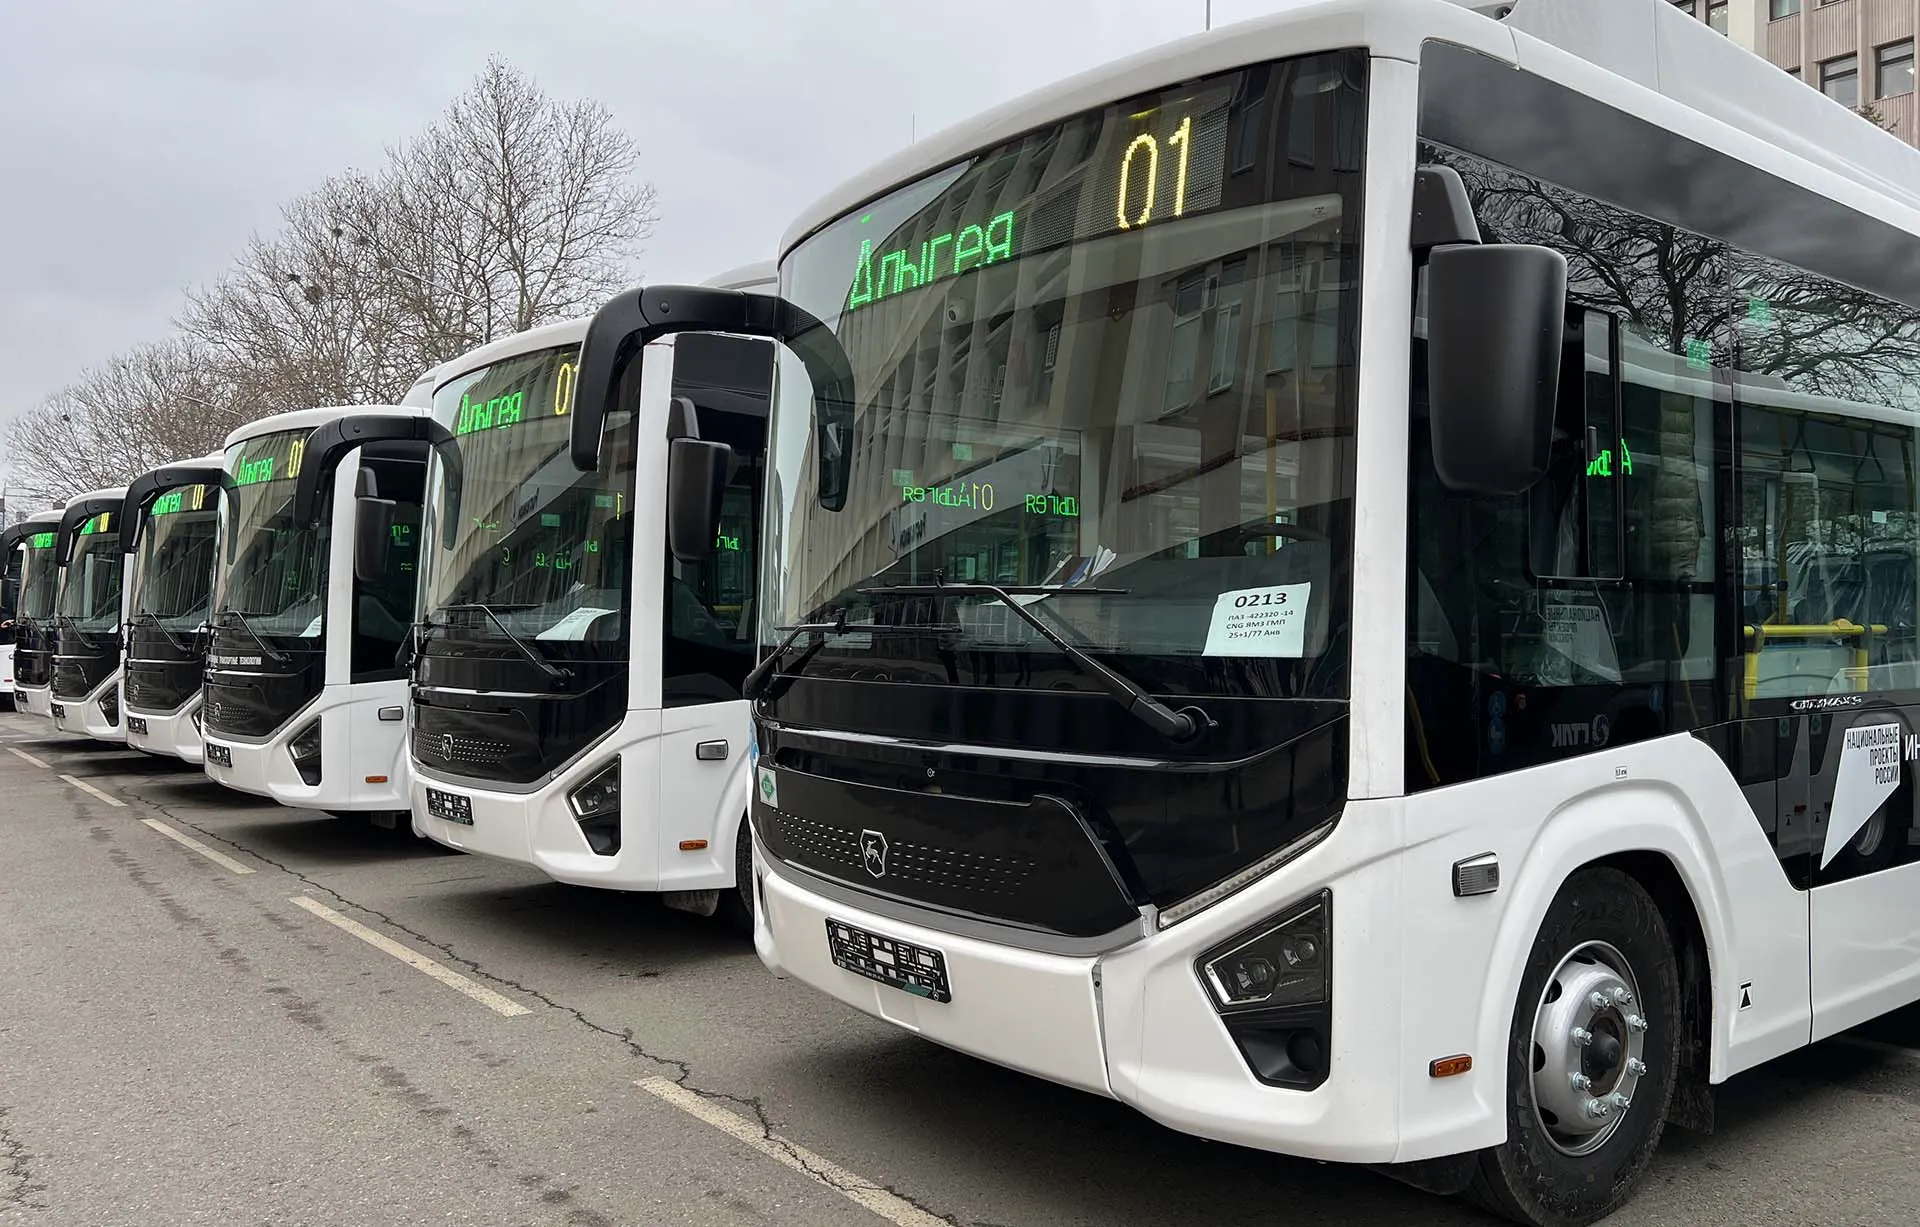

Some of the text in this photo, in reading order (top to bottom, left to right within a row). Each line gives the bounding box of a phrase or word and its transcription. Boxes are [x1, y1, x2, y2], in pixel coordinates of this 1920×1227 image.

[1117, 116, 1192, 230] 01
[555, 362, 579, 415] 0
[288, 438, 305, 479] 01
[1235, 592, 1288, 608] 0213
[1228, 630, 1262, 639] 25+1/77
[1847, 726, 1898, 750] НАЦИОНАЛЬНЫЕ
[1870, 746, 1899, 767] ПРОЕКТЫ
[1875, 765, 1899, 784] РОССИИ
